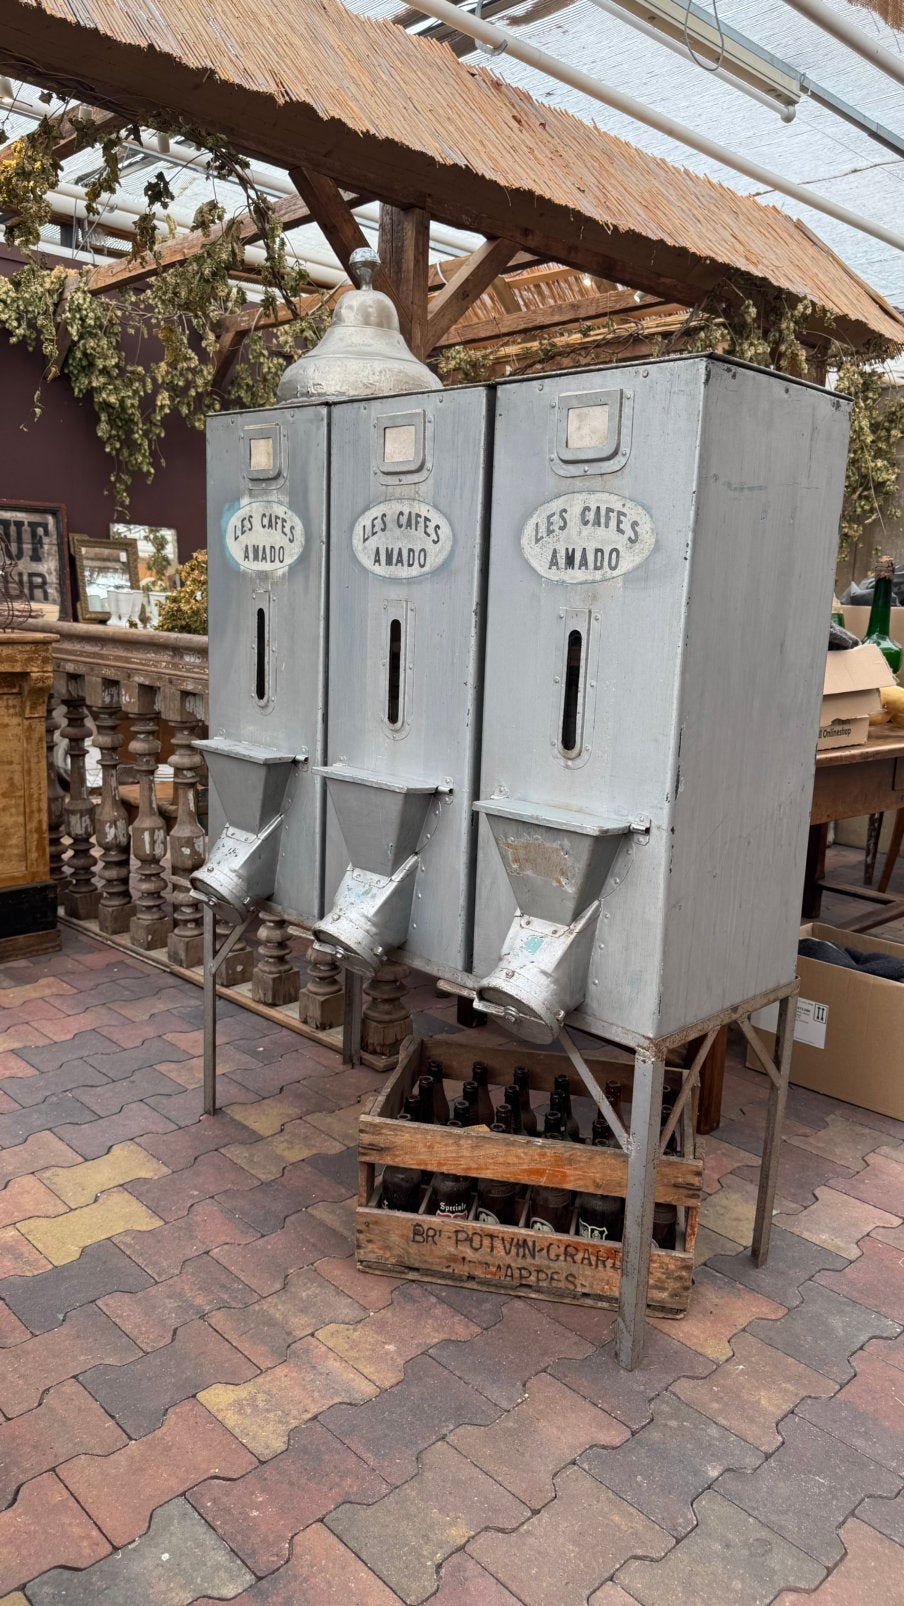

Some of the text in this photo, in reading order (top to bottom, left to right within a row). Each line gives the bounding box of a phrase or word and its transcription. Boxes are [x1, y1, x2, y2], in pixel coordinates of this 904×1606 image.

[234, 514, 253, 542] LES
[362, 513, 387, 544] LES
[534, 508, 568, 545] LES
[243, 544, 285, 564] AMADO
[373, 547, 427, 568] AMADO
[548, 547, 620, 571] AMADO
[823, 727, 852, 738] Onlineshop
